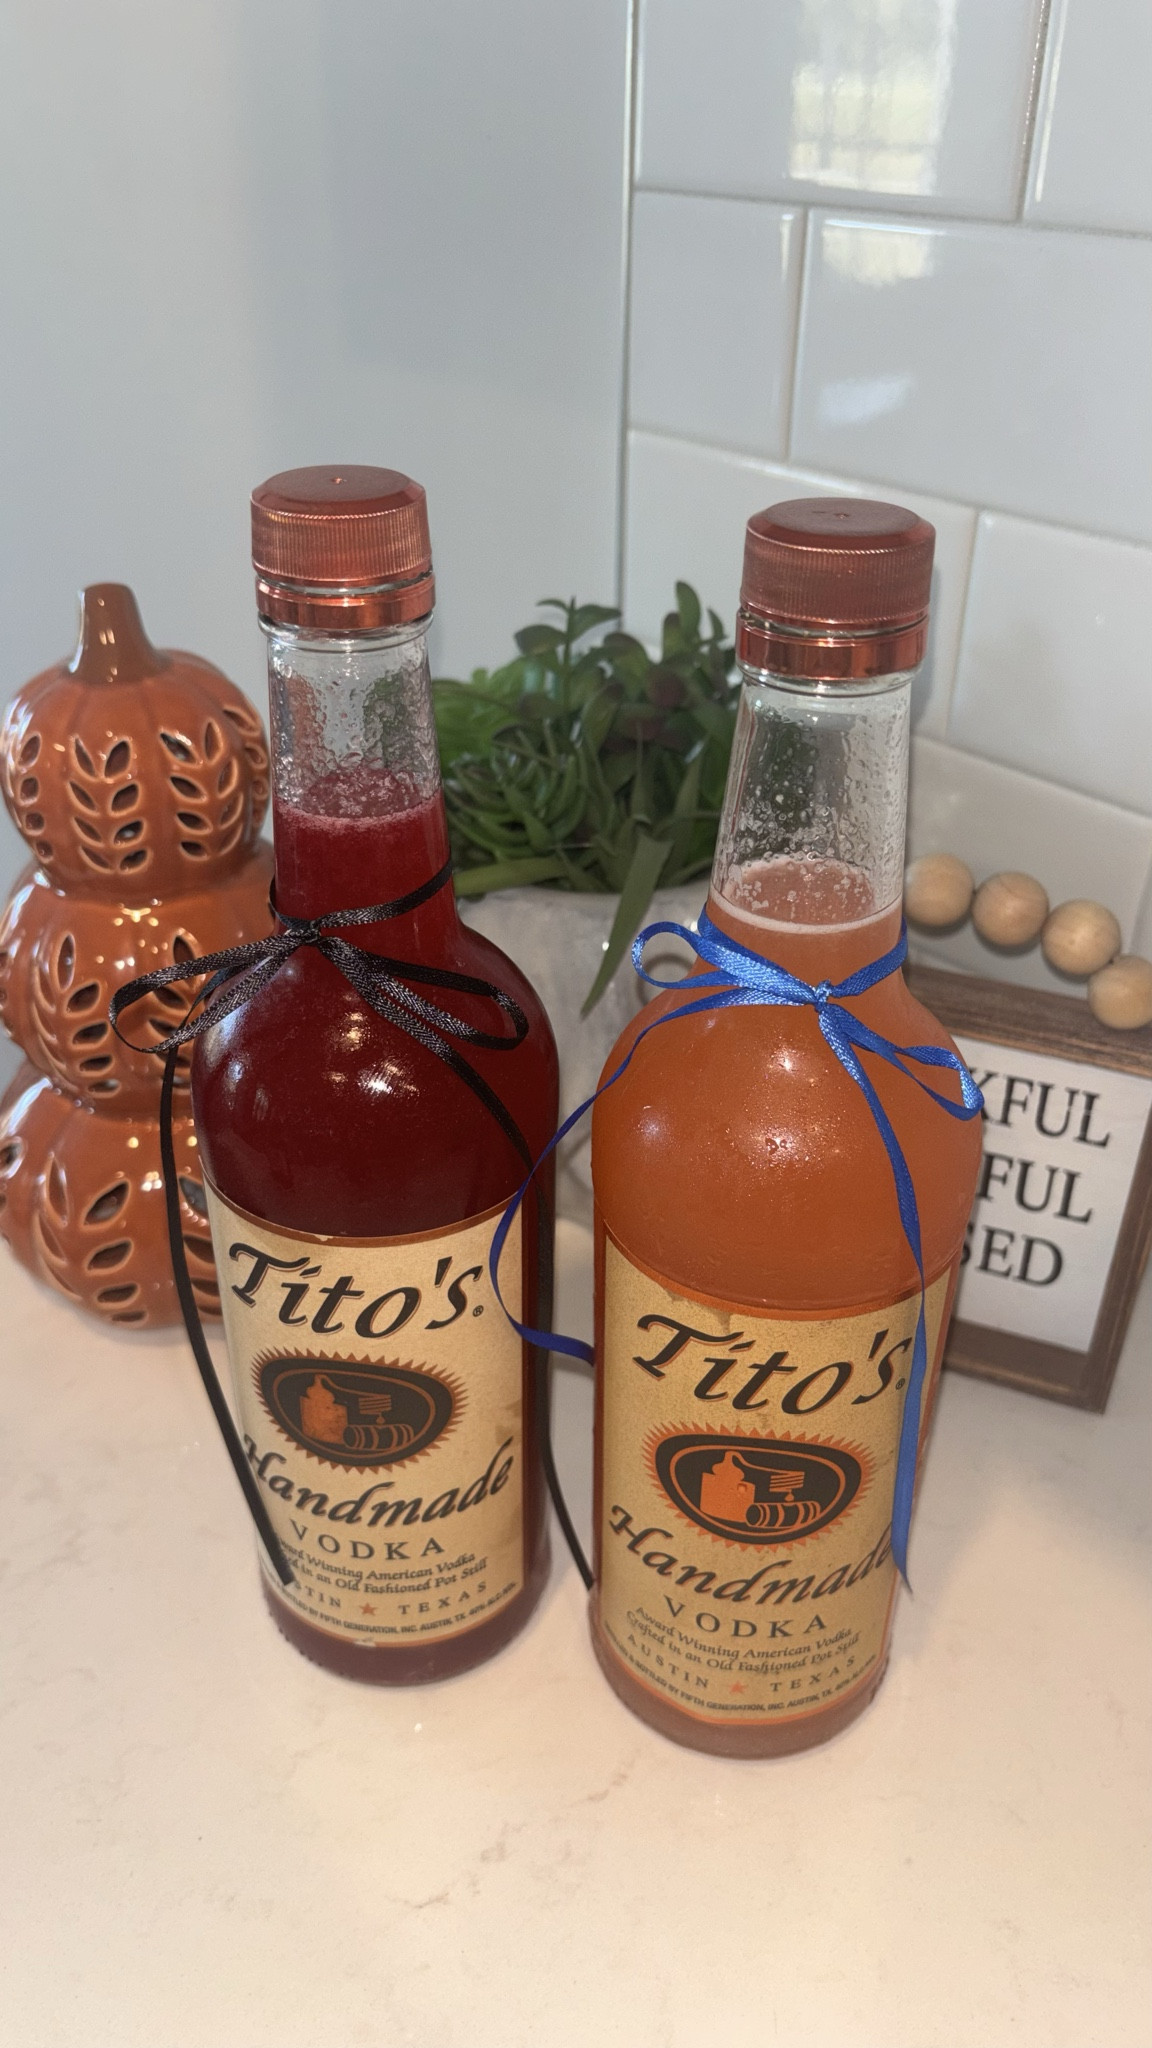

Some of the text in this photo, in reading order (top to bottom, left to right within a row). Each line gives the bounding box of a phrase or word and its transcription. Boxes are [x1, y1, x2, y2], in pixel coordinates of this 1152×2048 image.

[244, 1434, 514, 1528] Handmade
[290, 1518, 445, 1561] VODKA
[306, 1552, 364, 1582] Winning
[365, 1566, 433, 1582] American
[435, 1552, 476, 1574] Vodka
[316, 1572, 332, 1585] an
[334, 1576, 361, 1592] Old
[363, 1577, 432, 1595] Fashioned
[434, 1573, 457, 1588] Pot
[460, 1556, 488, 1580] Still
[397, 1580, 488, 1616] TEXAS
[663, 1593, 827, 1639] VODKA
[626, 1609, 862, 1676] Crafted in an Old Fashioned Pot Still
[636, 1606, 853, 1660] Award Winning American Vodka
[626, 1633, 709, 1689] AUSTIN
[769, 1655, 856, 1693] TEXAS
